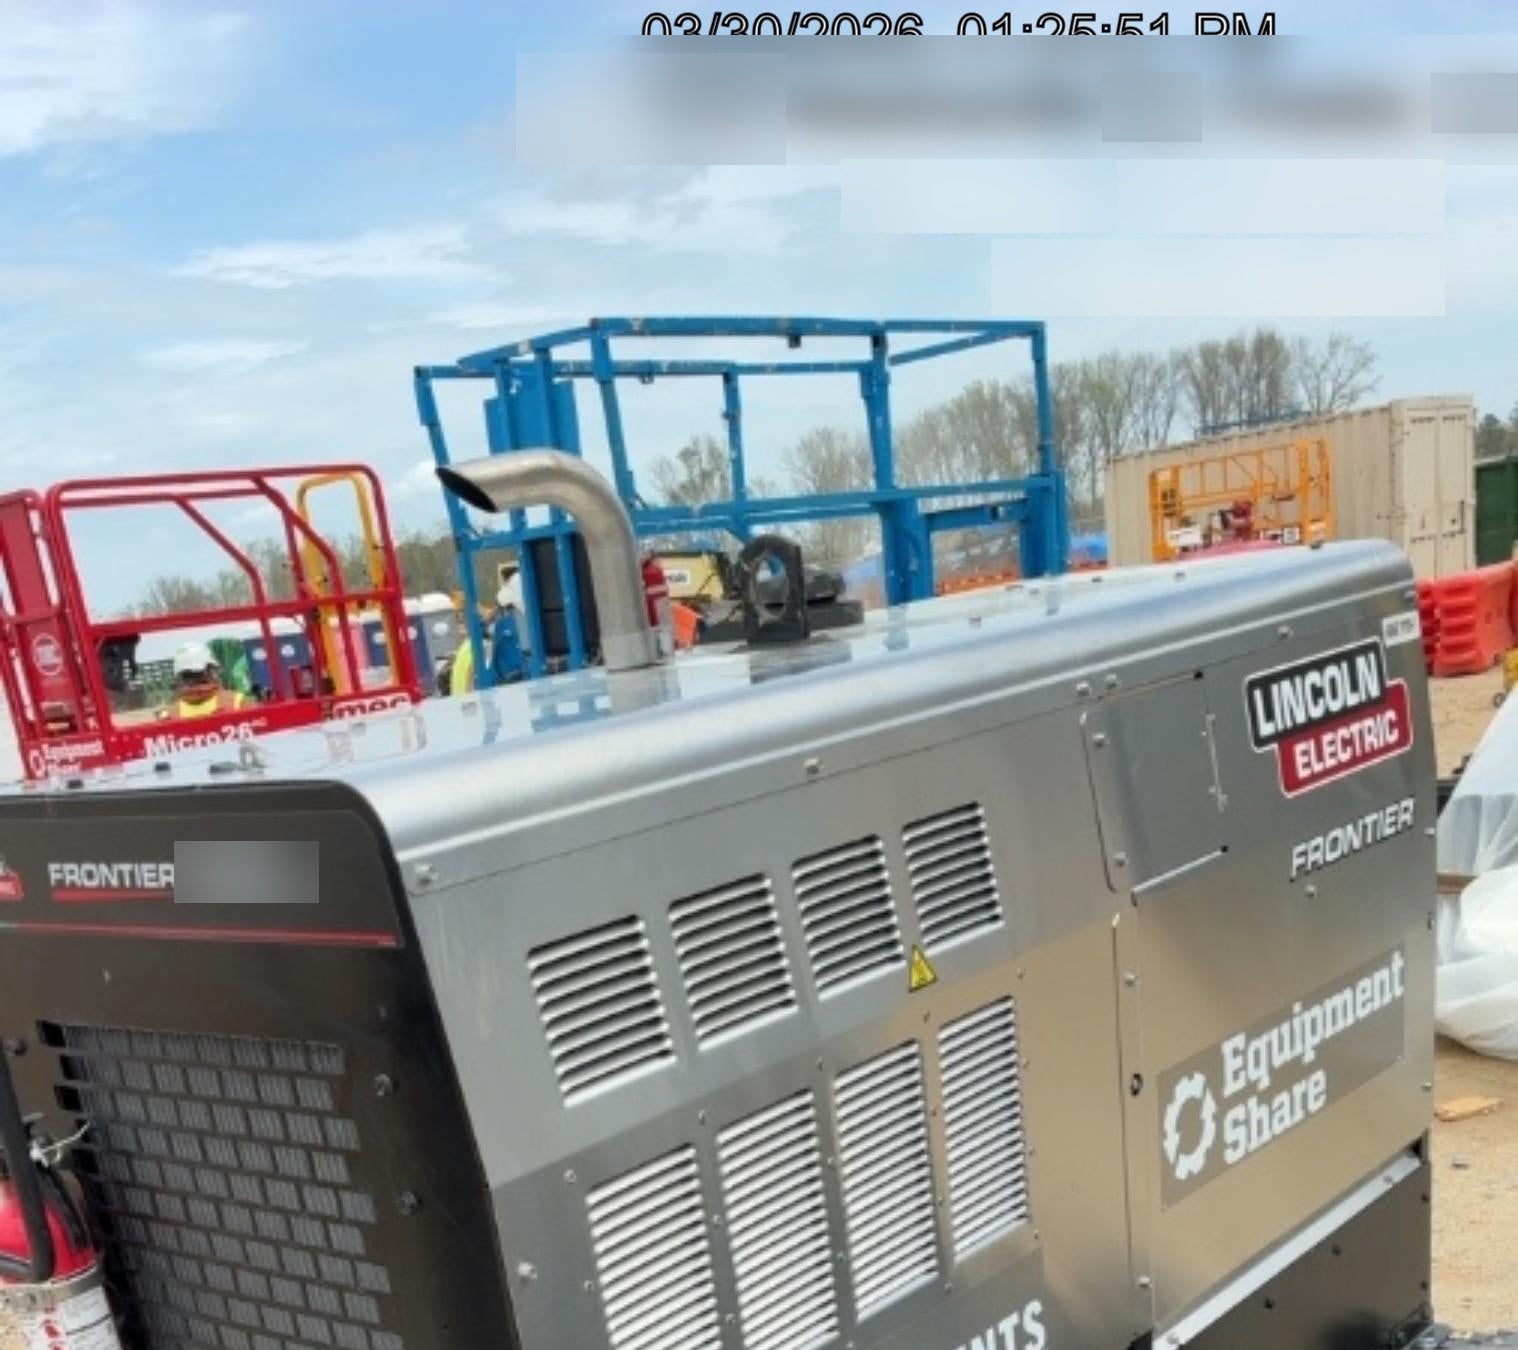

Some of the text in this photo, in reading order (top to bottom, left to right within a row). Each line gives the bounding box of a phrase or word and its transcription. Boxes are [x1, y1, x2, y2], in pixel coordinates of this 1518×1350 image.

[1253, 652, 1381, 738] LINCOLN
[1295, 709, 1400, 780] ELECTRIC
[47, 862, 174, 889] FRONTIER
[1290, 797, 1416, 879] FRONTIER
[1221, 950, 1405, 1099] Equipment
[1223, 1068, 1328, 1166] Share
